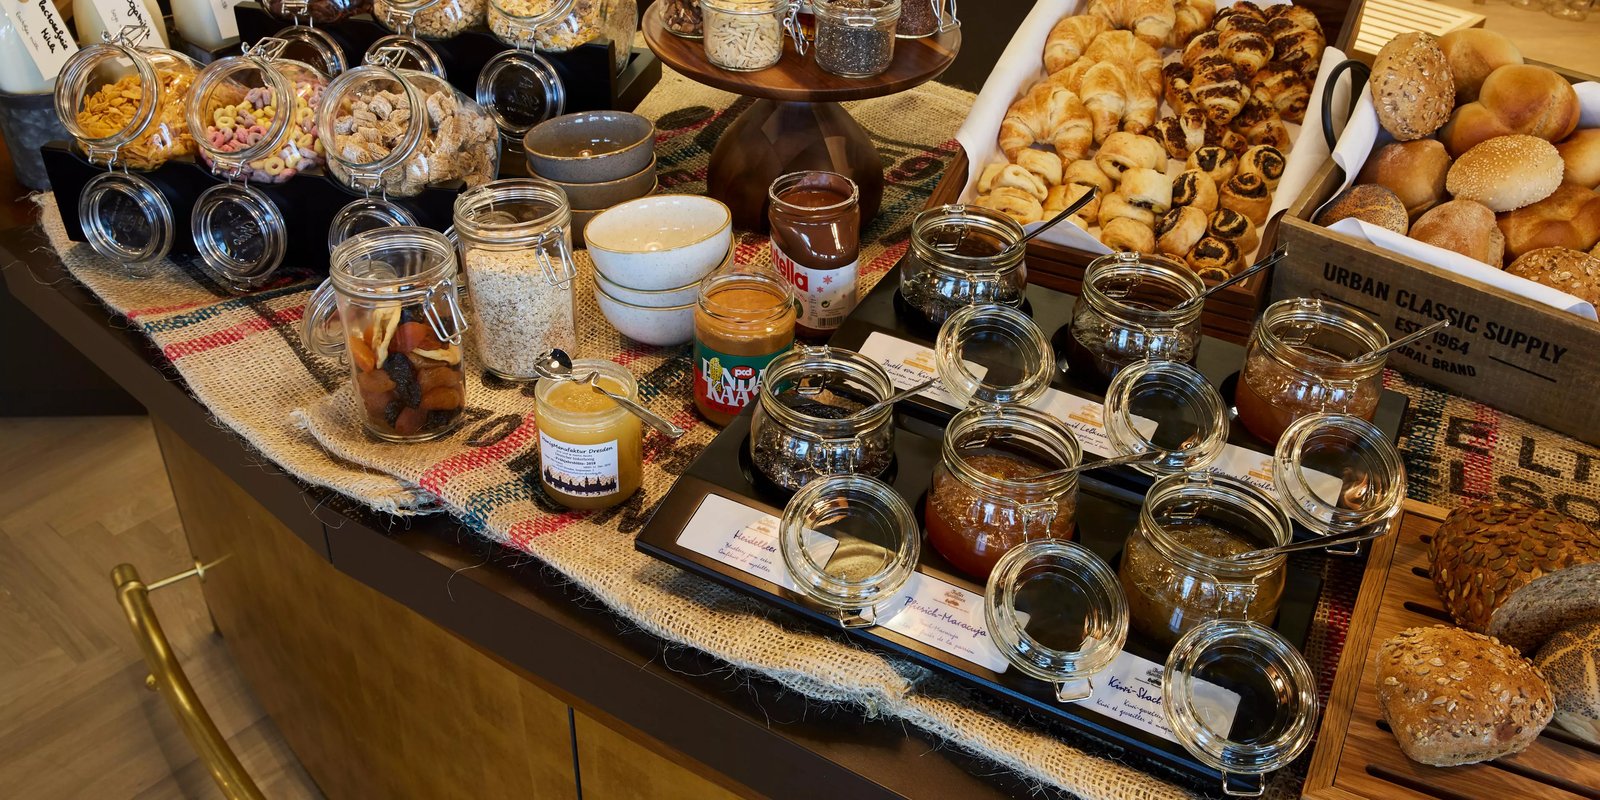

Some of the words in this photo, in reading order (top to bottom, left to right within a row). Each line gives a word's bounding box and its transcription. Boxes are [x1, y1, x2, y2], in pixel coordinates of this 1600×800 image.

[1324, 262, 1391, 301] URBAN
[1396, 289, 1478, 333] CLASSIC
[1484, 321, 1567, 364] SUPPLY
[1432, 331, 1470, 356] 1964
[1432, 357, 1476, 377] BRAND
[589, 446, 613, 454] Dresden
